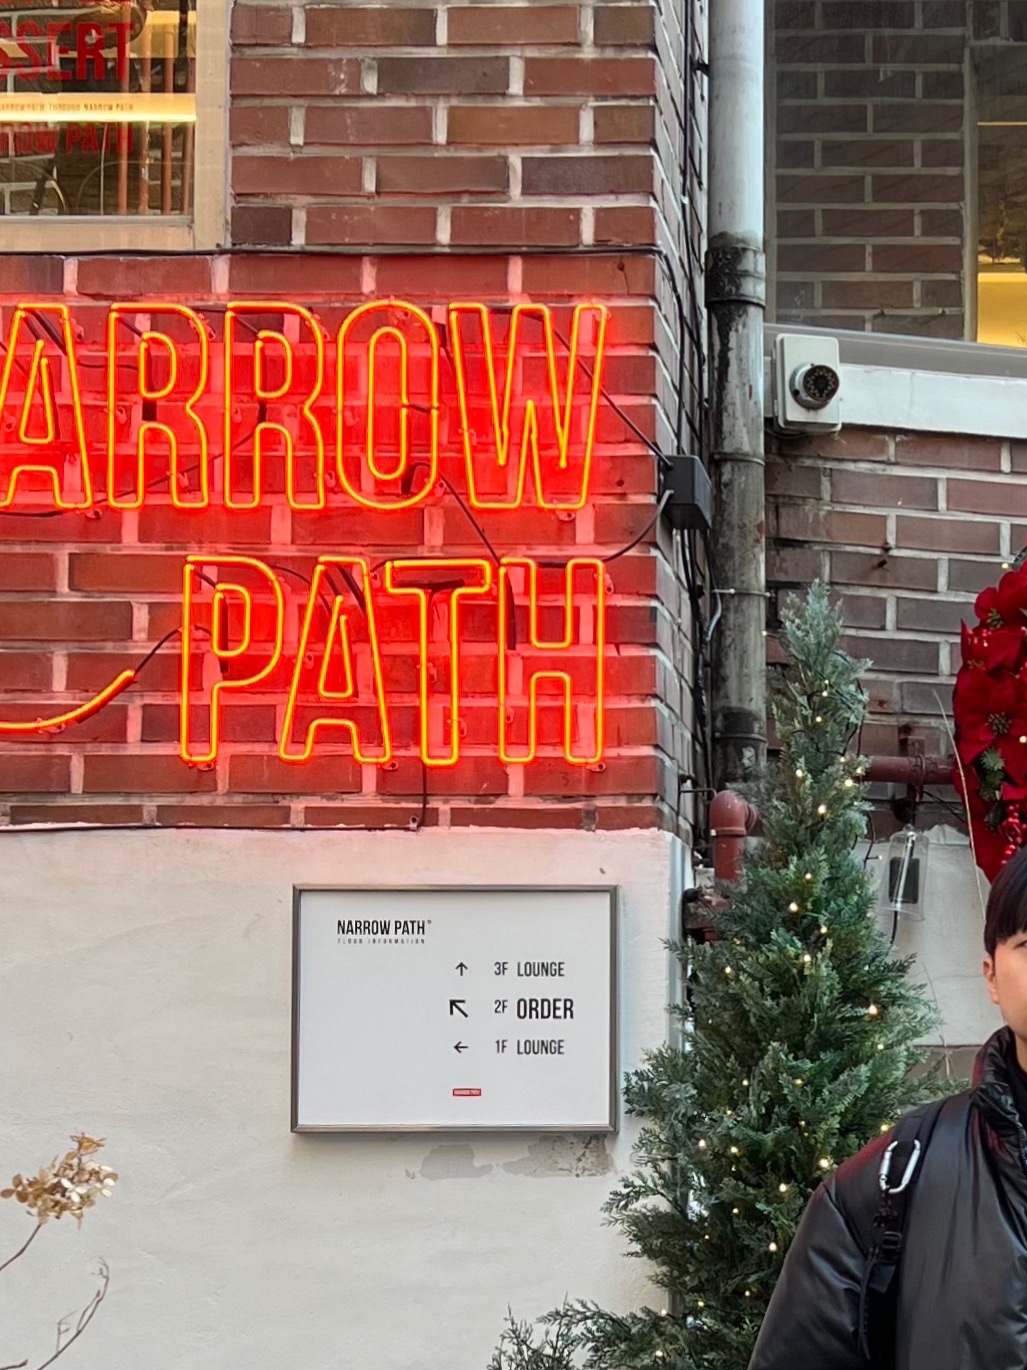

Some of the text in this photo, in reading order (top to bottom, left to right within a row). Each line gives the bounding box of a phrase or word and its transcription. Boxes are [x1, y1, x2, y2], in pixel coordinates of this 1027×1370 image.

[0, 300, 609, 510] ARROW
[180, 555, 605, 767] PATH
[337, 919, 391, 935] NARROW
[494, 961, 565, 977] 3F LOUNGE
[494, 998, 574, 1019] 2F ORDER
[495, 1039, 565, 1055] 1F LOUNGE
